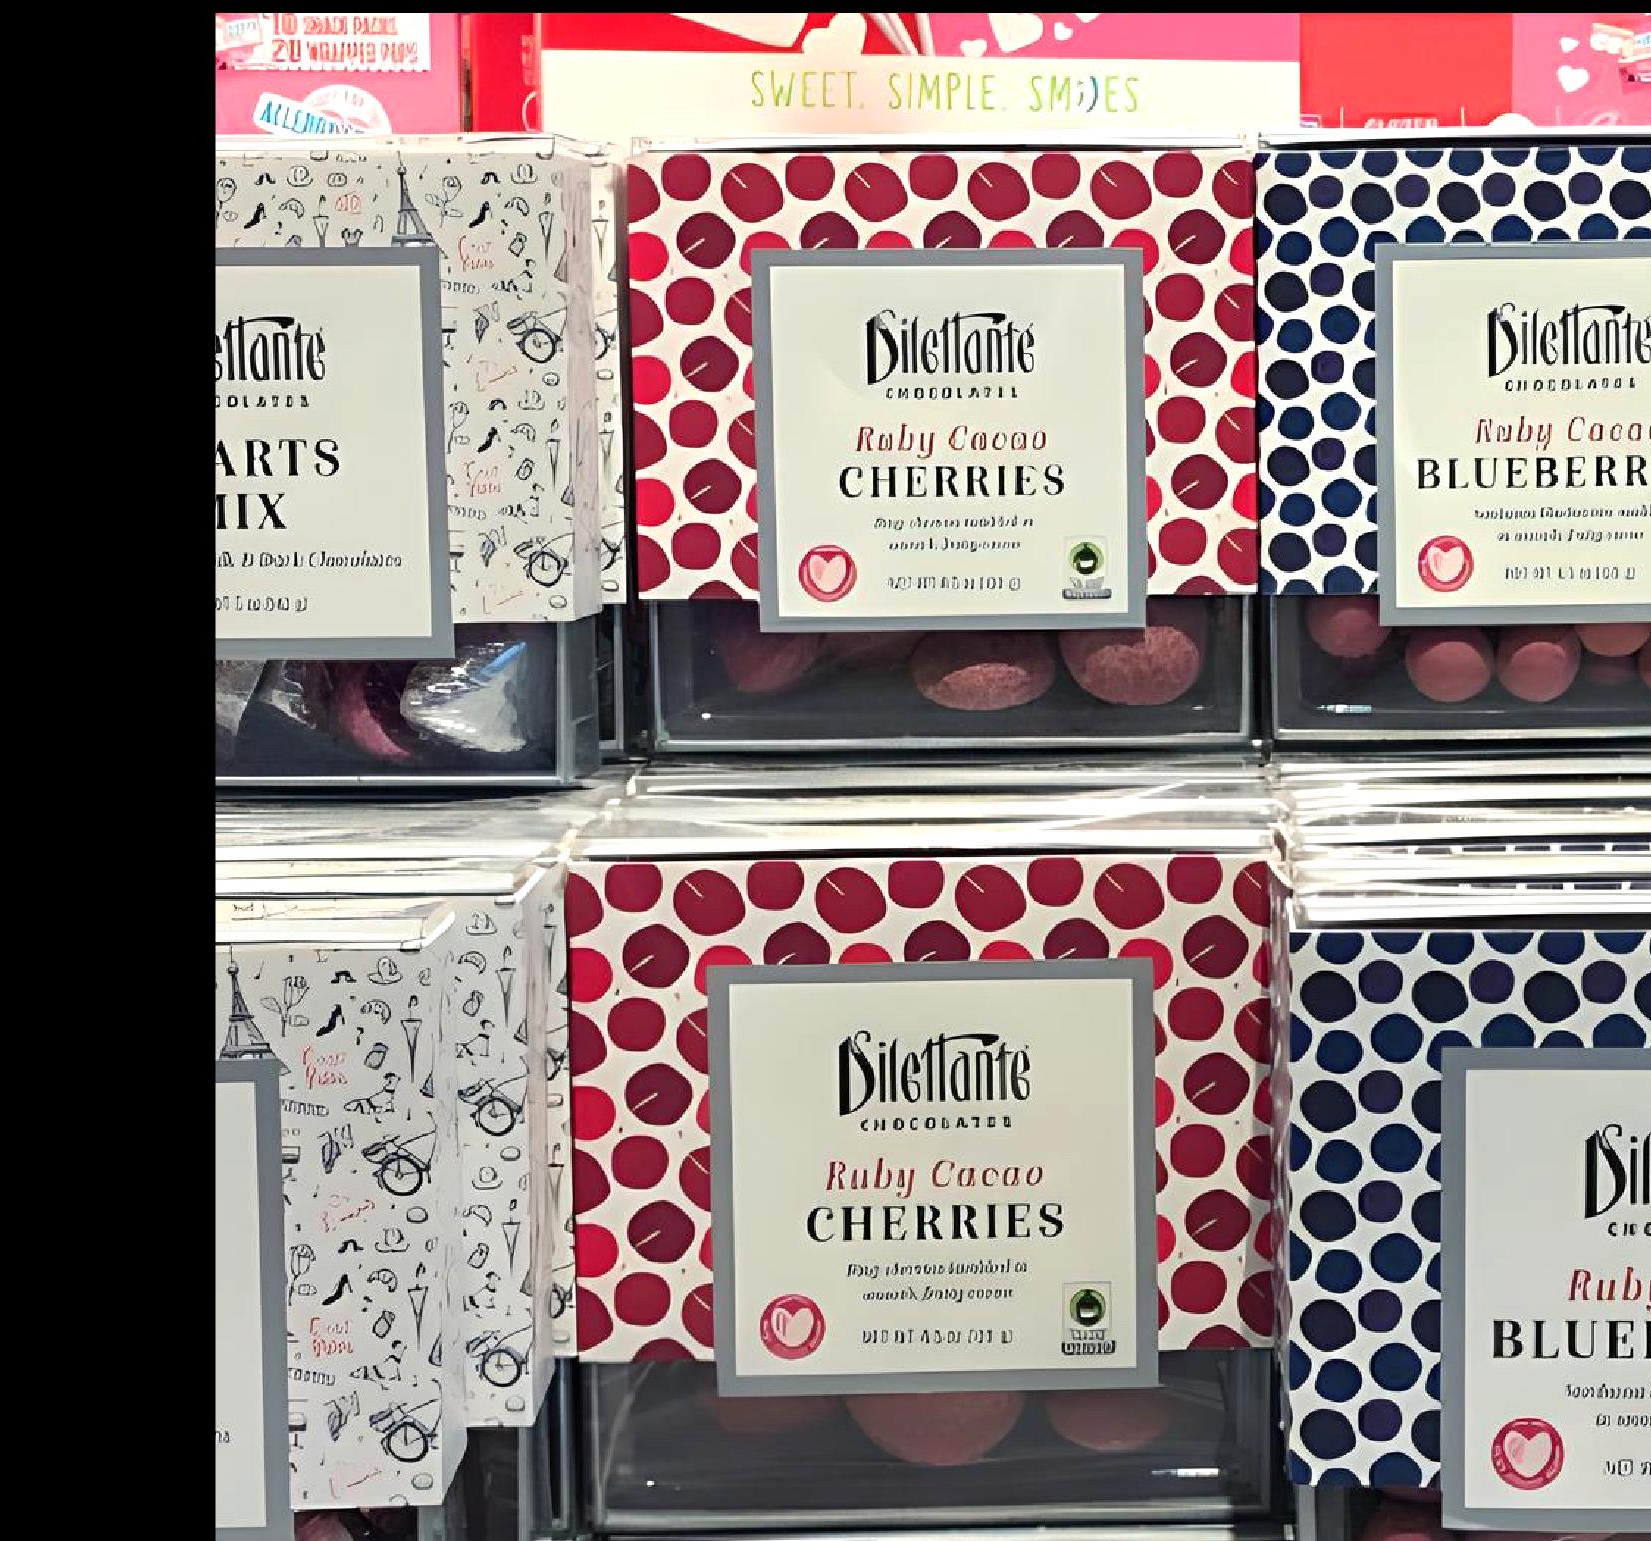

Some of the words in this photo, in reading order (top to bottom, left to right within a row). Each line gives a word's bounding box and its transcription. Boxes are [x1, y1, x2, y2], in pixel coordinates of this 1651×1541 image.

[751, 69, 866, 110] SWEET.
[888, 71, 1008, 112] SIMPLE.
[838, 464, 1065, 498] CHERRIES
[825, 1158, 916, 1199] Ruby
[931, 1158, 1044, 1188] Cacao
[806, 1202, 1065, 1243] CHERRIES
